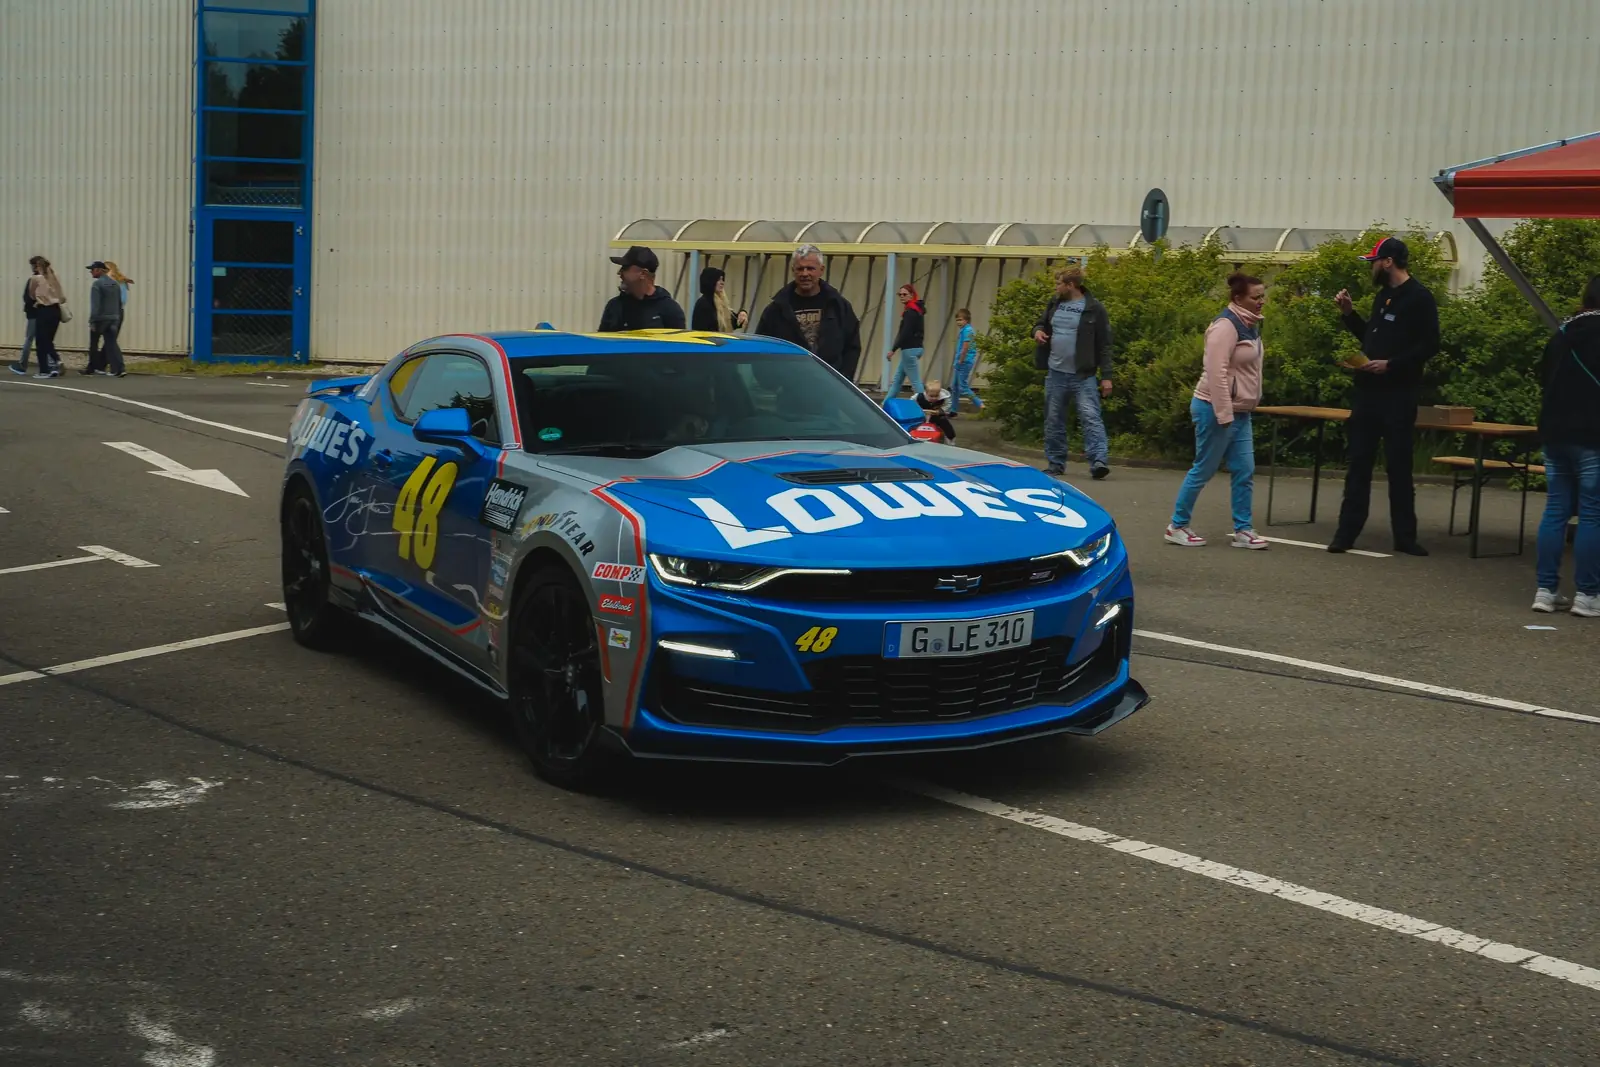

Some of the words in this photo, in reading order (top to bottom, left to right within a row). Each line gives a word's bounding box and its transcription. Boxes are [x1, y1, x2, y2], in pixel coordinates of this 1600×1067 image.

[392, 455, 459, 570] 48
[594, 563, 631, 580] COMP
[795, 626, 839, 653] 48
[911, 626, 929, 653] G
[948, 623, 981, 652] LE
[984, 615, 1026, 648] 310
